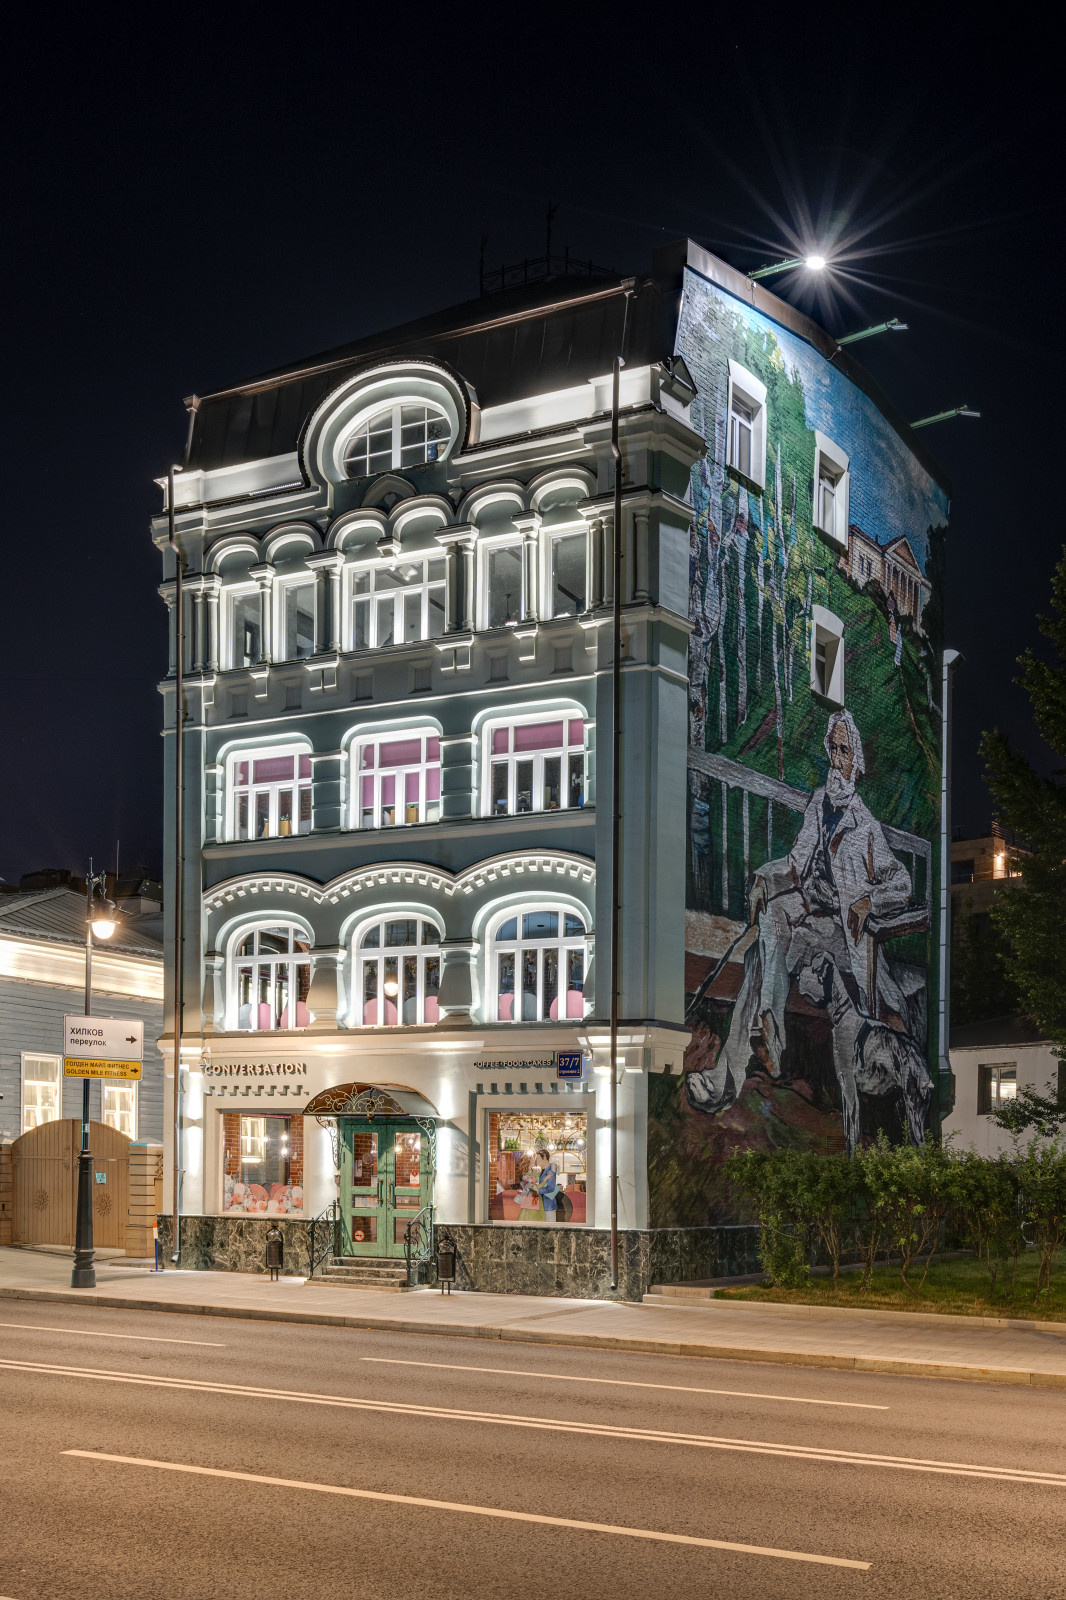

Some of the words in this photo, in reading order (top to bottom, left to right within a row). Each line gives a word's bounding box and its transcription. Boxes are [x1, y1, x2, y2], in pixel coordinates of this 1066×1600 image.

[70, 1027, 103, 1036] ХИЛКОВ
[70, 1038, 107, 1046] переулок
[560, 1057, 580, 1069] 37/7
[205, 1062, 305, 1075] CONVERSATION
